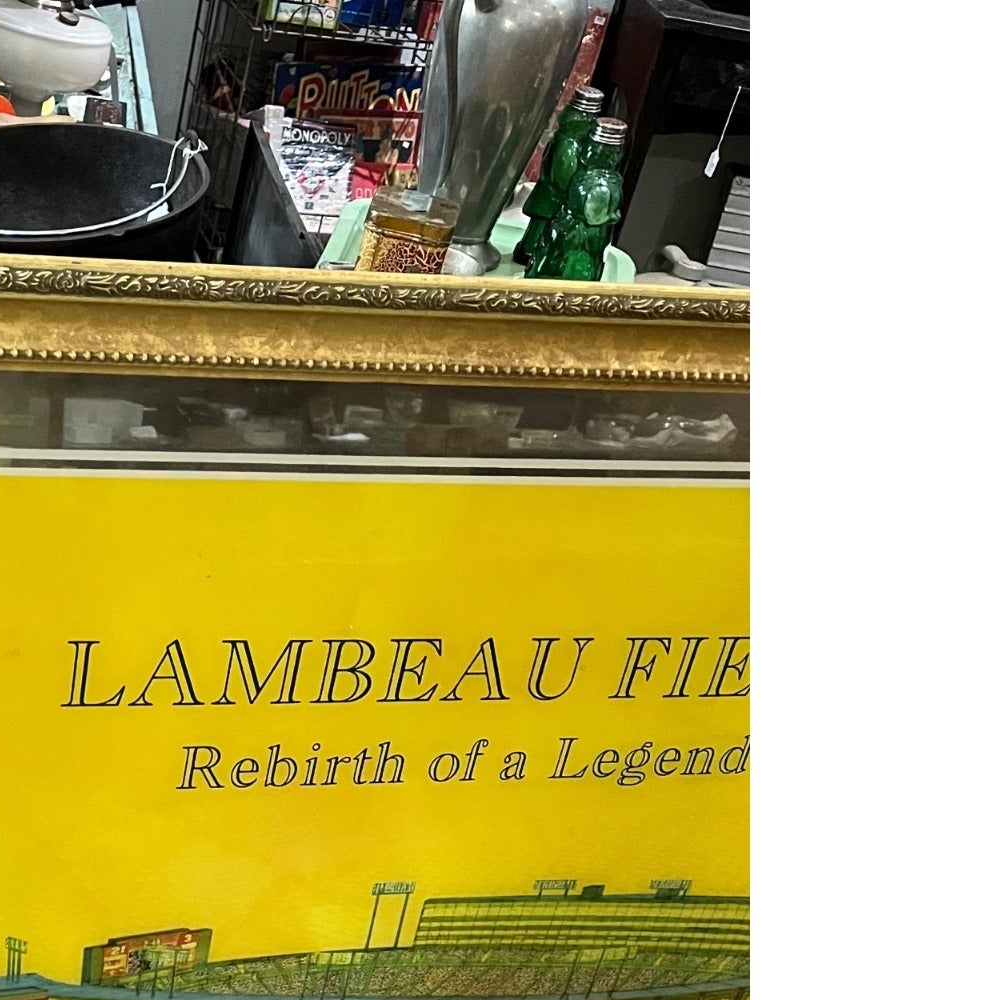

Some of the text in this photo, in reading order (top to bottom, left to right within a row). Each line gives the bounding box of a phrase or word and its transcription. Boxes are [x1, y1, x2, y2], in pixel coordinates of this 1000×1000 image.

[282, 127, 351, 146] MONOPOLY
[61, 637, 595, 707] LAMBEAU
[176, 734, 750, 790] Rebirth of a Legend
